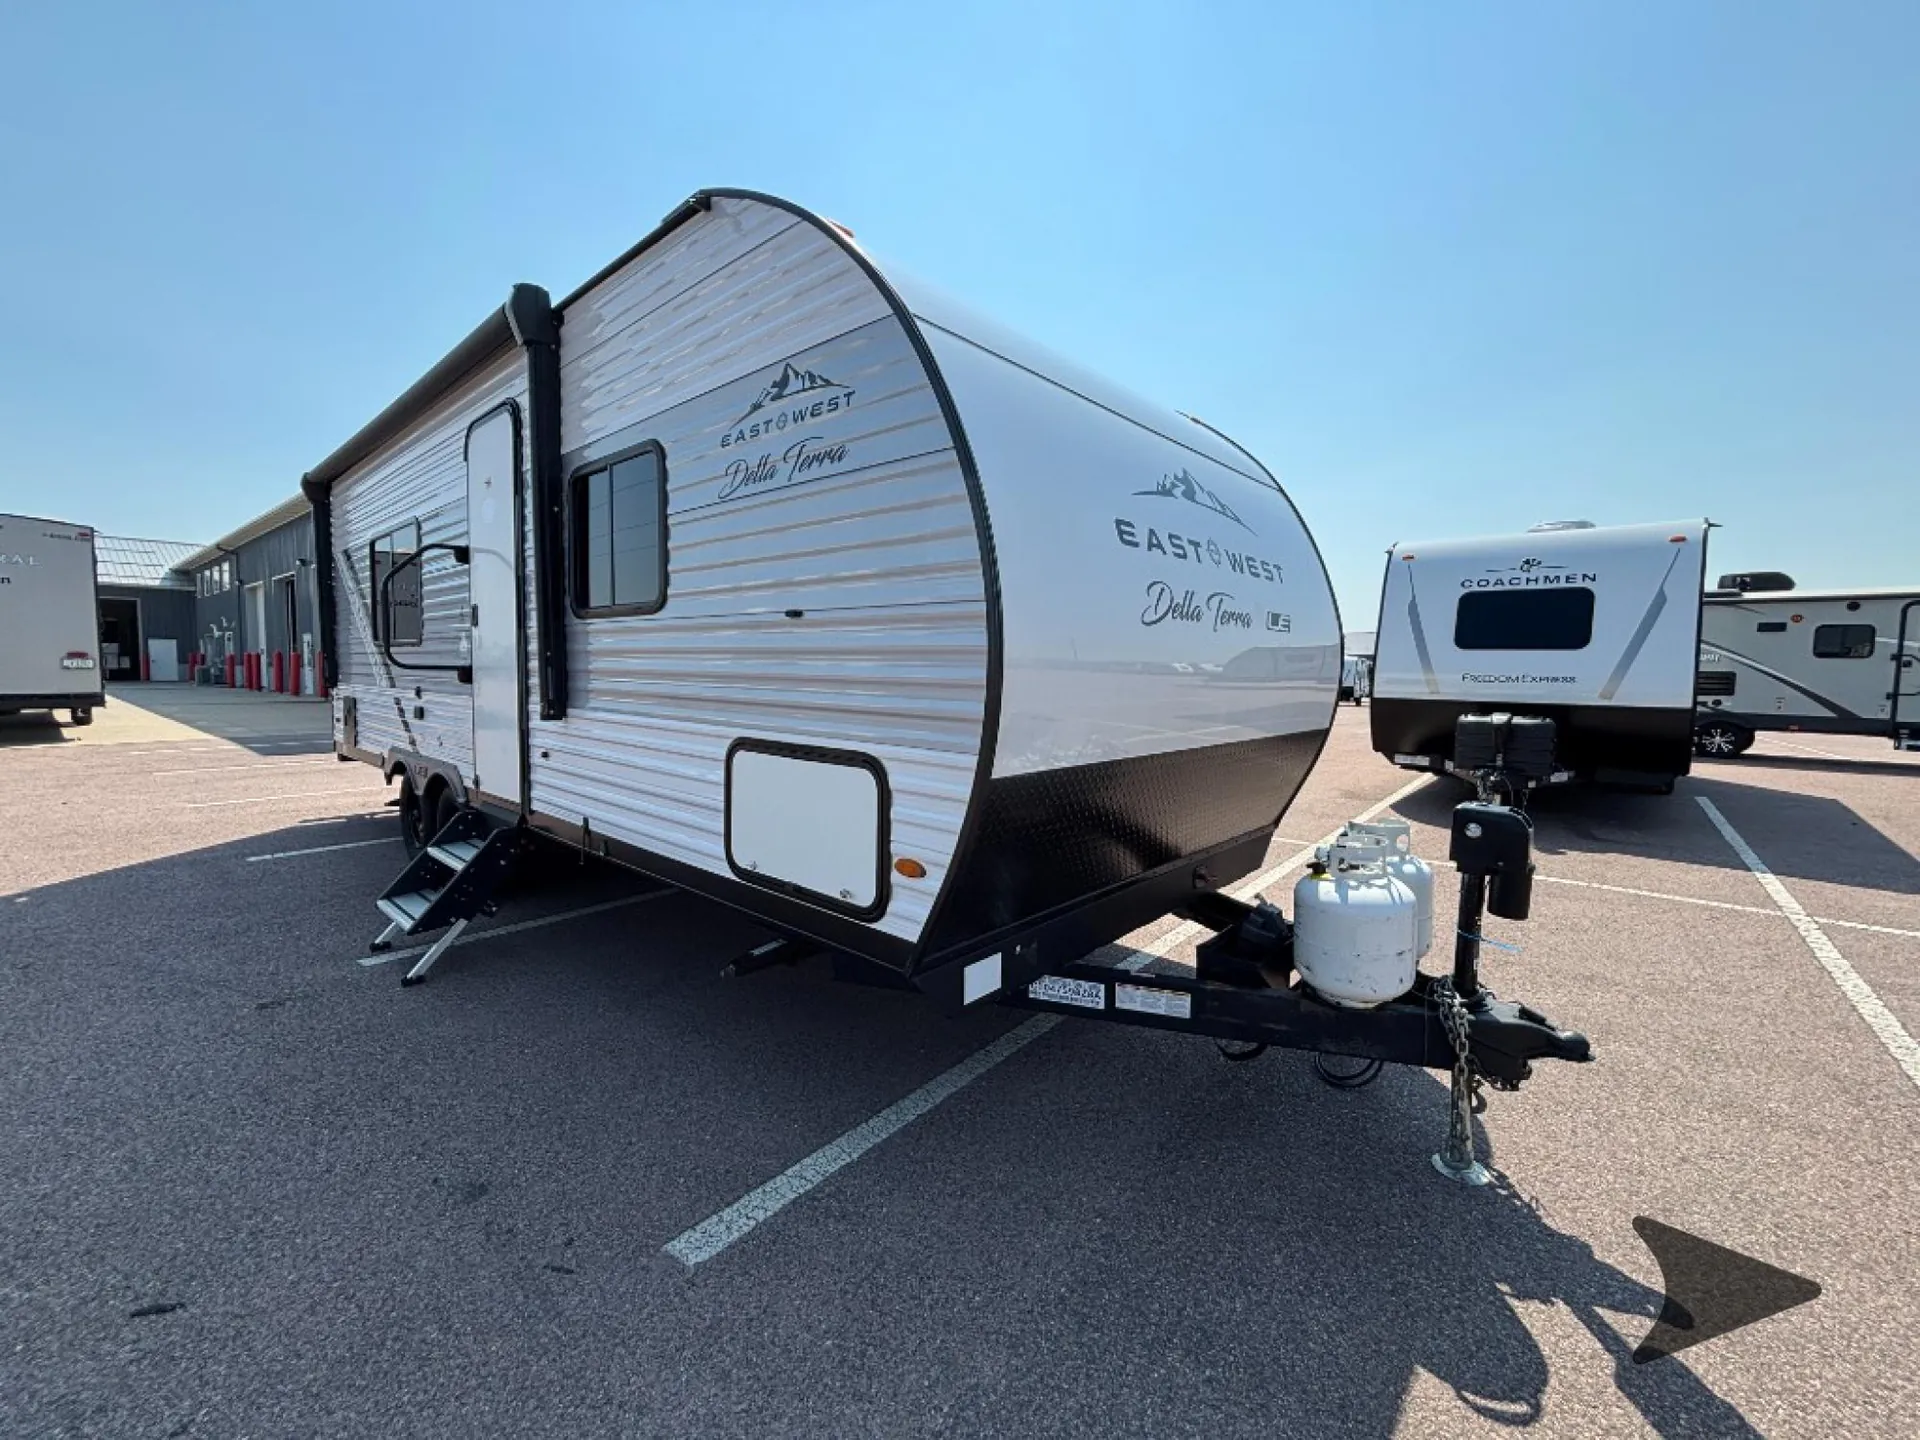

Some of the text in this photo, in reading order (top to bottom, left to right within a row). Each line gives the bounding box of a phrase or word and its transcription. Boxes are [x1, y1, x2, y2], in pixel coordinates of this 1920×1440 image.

[720, 390, 855, 449] EAST WEST
[718, 436, 850, 499] Della Terra
[1114, 517, 1283, 584] EAST WEST
[1141, 580, 1204, 627] Della
[1206, 592, 1252, 633] Terra
[1460, 573, 1597, 589] COACHMEN
